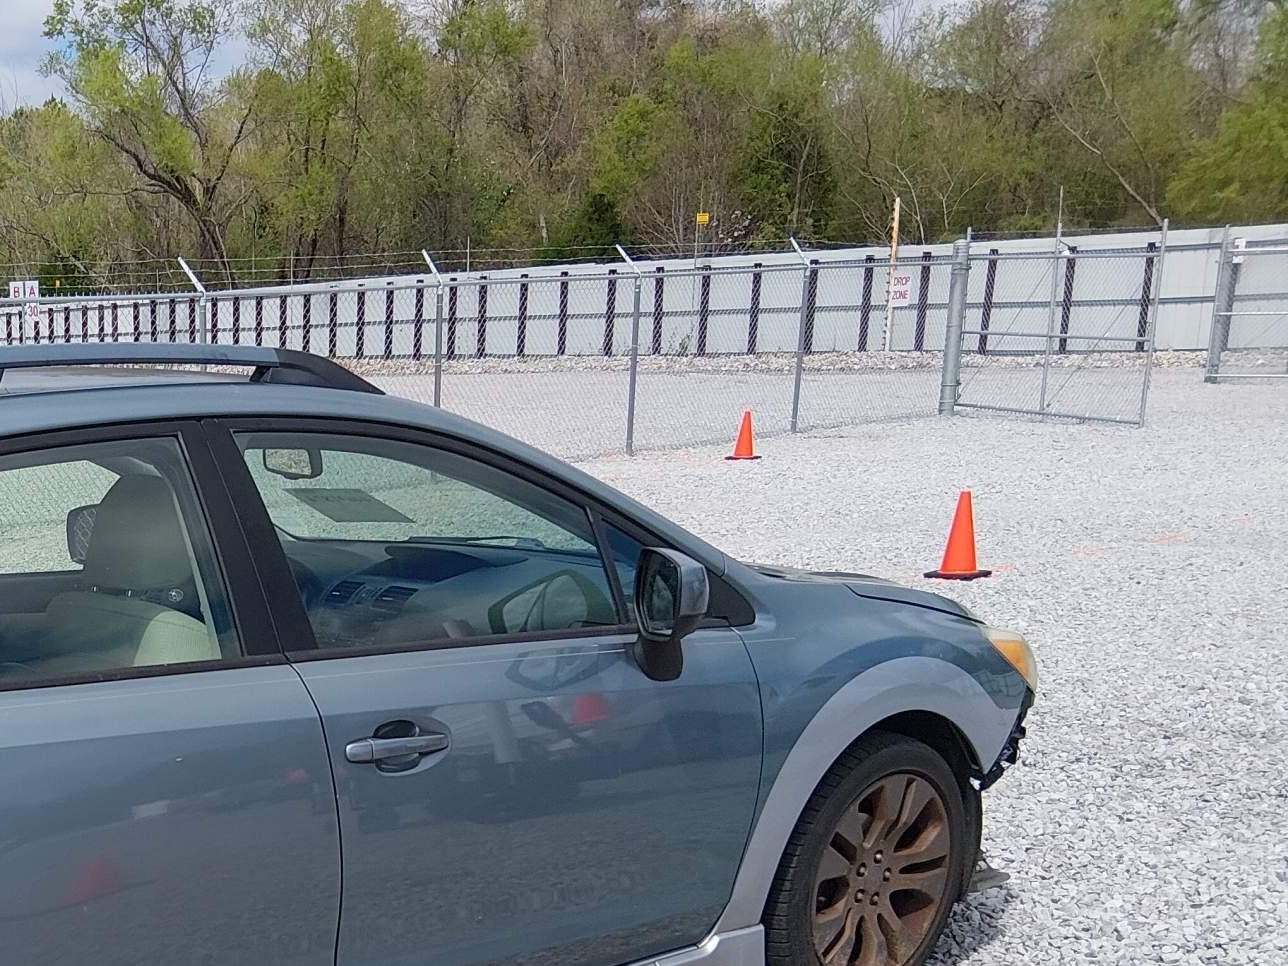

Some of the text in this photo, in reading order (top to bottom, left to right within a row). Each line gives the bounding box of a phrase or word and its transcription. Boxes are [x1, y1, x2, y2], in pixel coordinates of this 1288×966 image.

[893, 276, 911, 286] DROP
[13, 286, 20, 298] B
[28, 285, 36, 297] A
[892, 290, 909, 300] ZONE
[28, 304, 39, 317] 30
